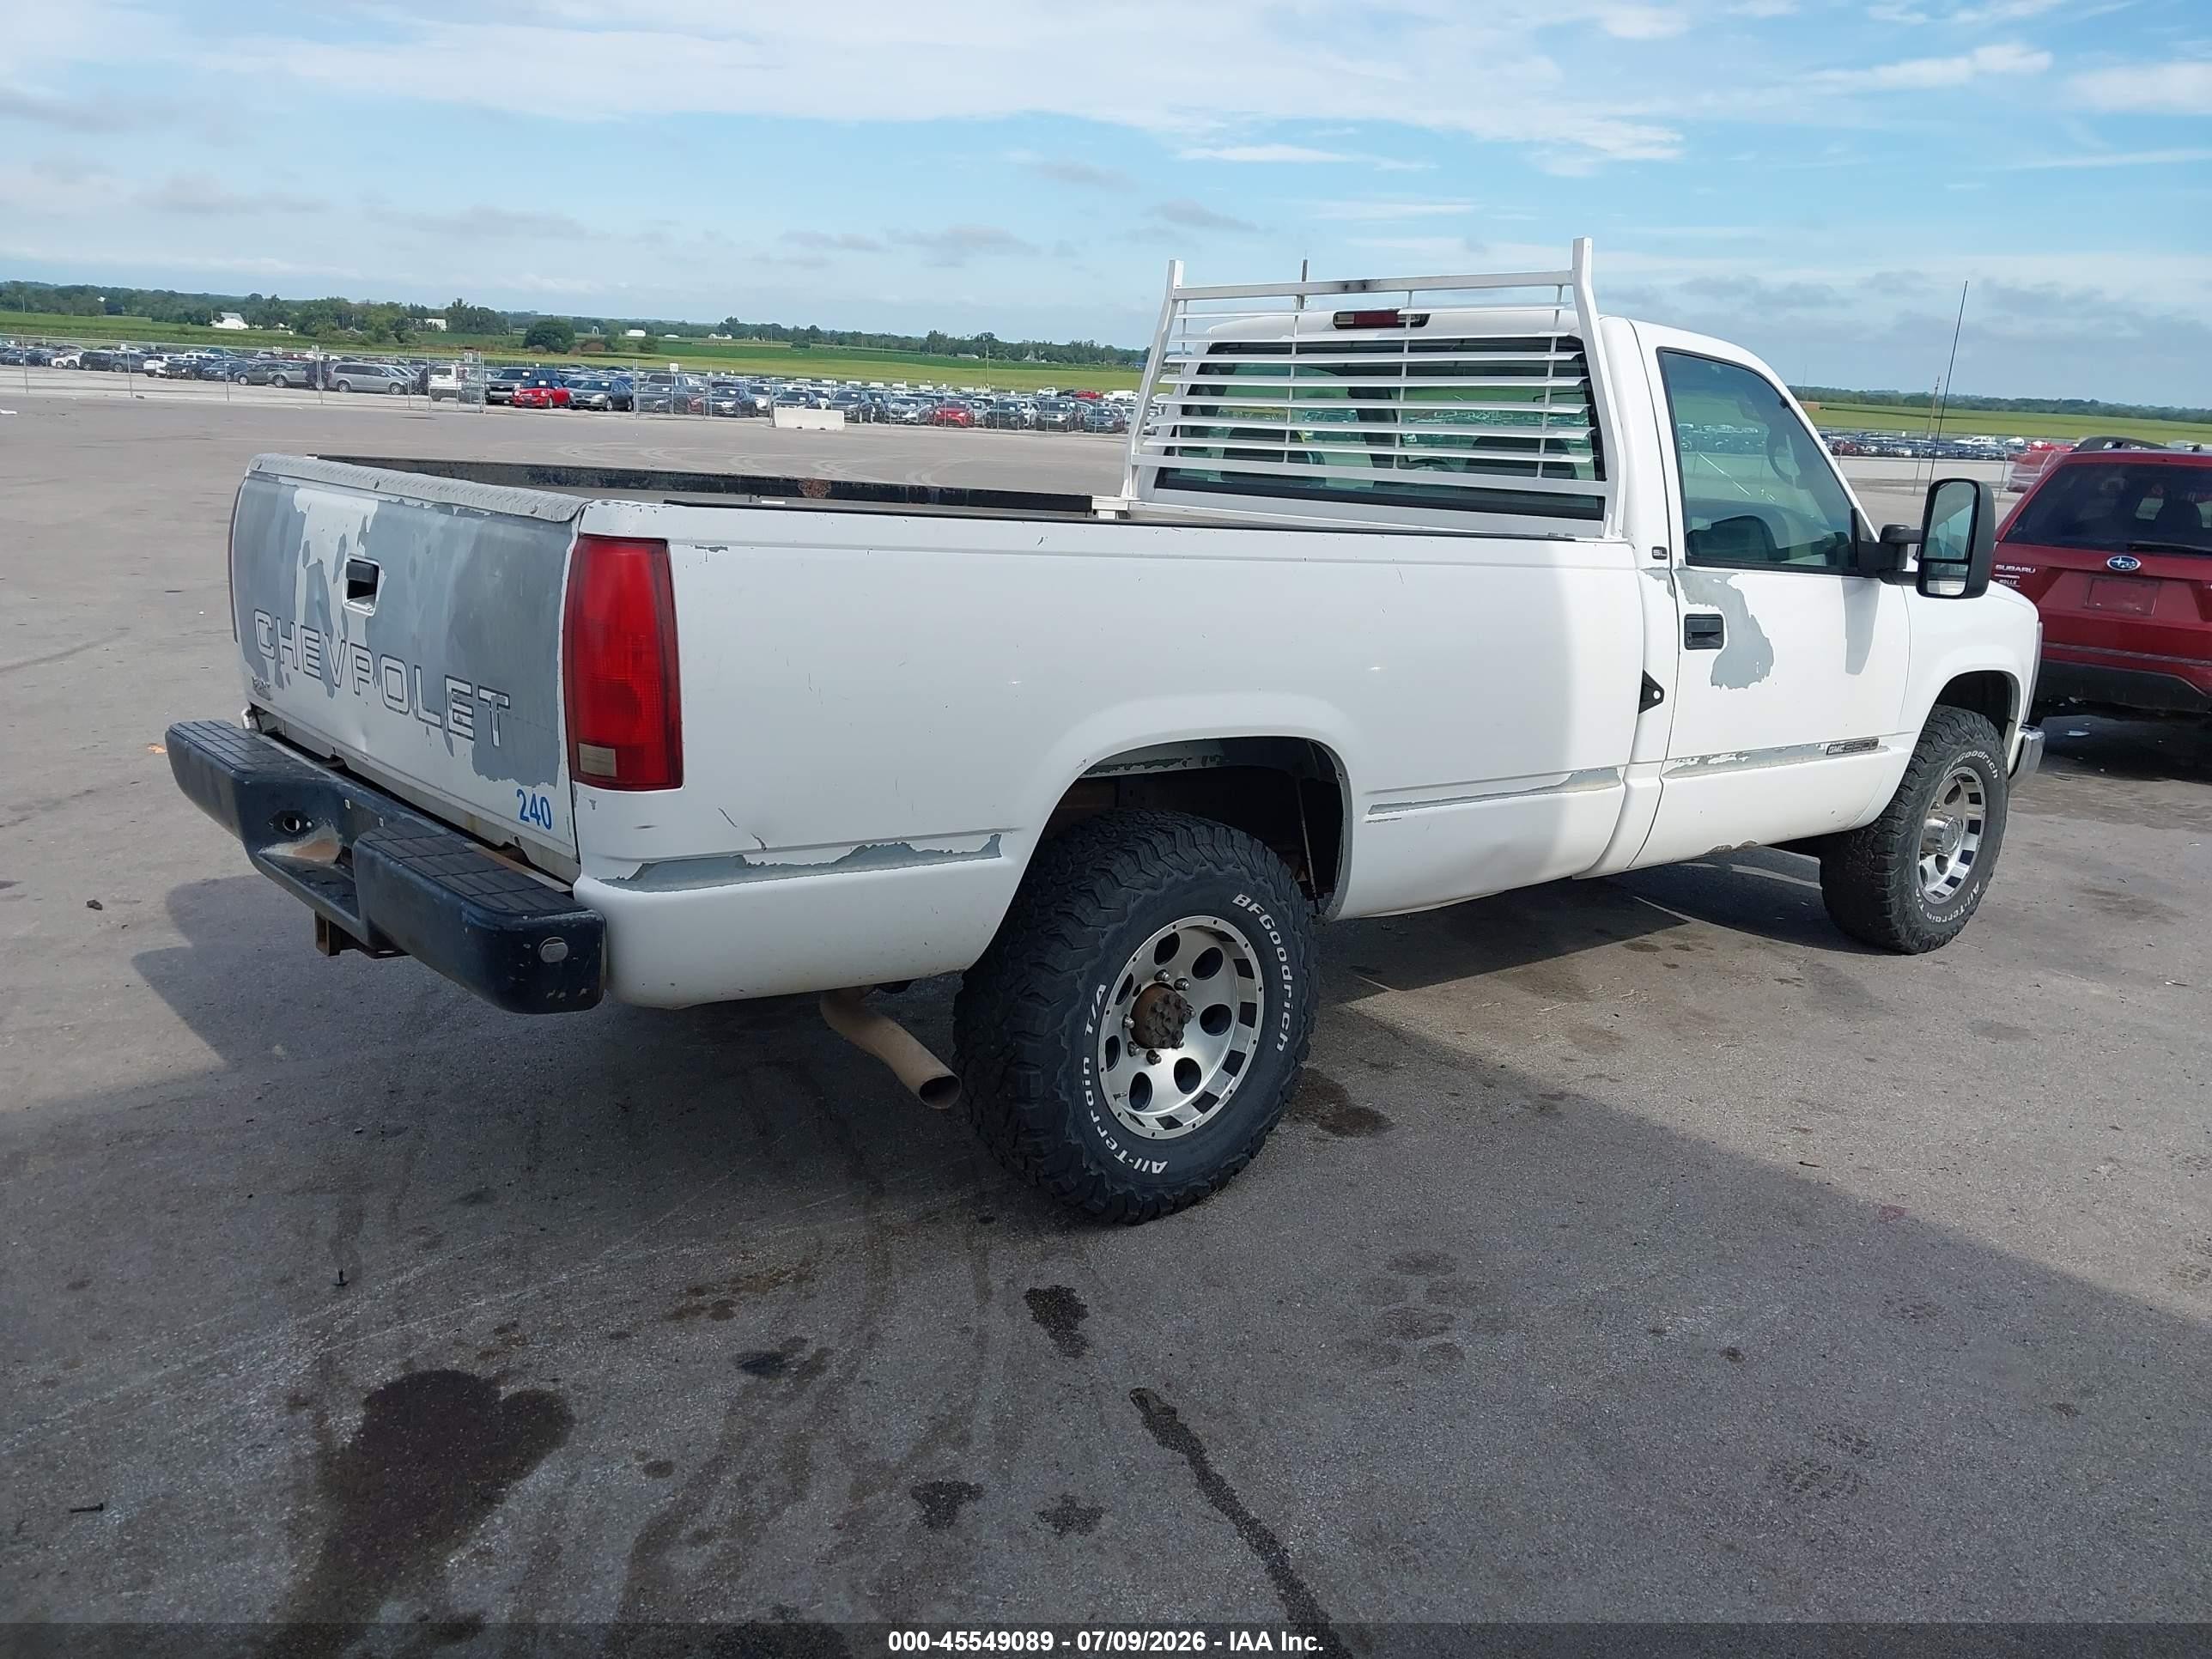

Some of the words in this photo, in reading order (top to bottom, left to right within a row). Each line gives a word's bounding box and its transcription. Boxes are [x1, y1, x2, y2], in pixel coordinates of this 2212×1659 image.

[1996, 564, 2036, 573] SUBARU
[253, 608, 511, 748] CHEVROLET
[1827, 744, 1844, 754] GMC
[516, 788, 552, 830] 240
[1926, 880, 1979, 923] All-Terrain
[1231, 893, 1294, 1053] BFGoodrich
[1084, 983, 1107, 1037] T/A
[1082, 1056, 1169, 1174] All-Terrain
